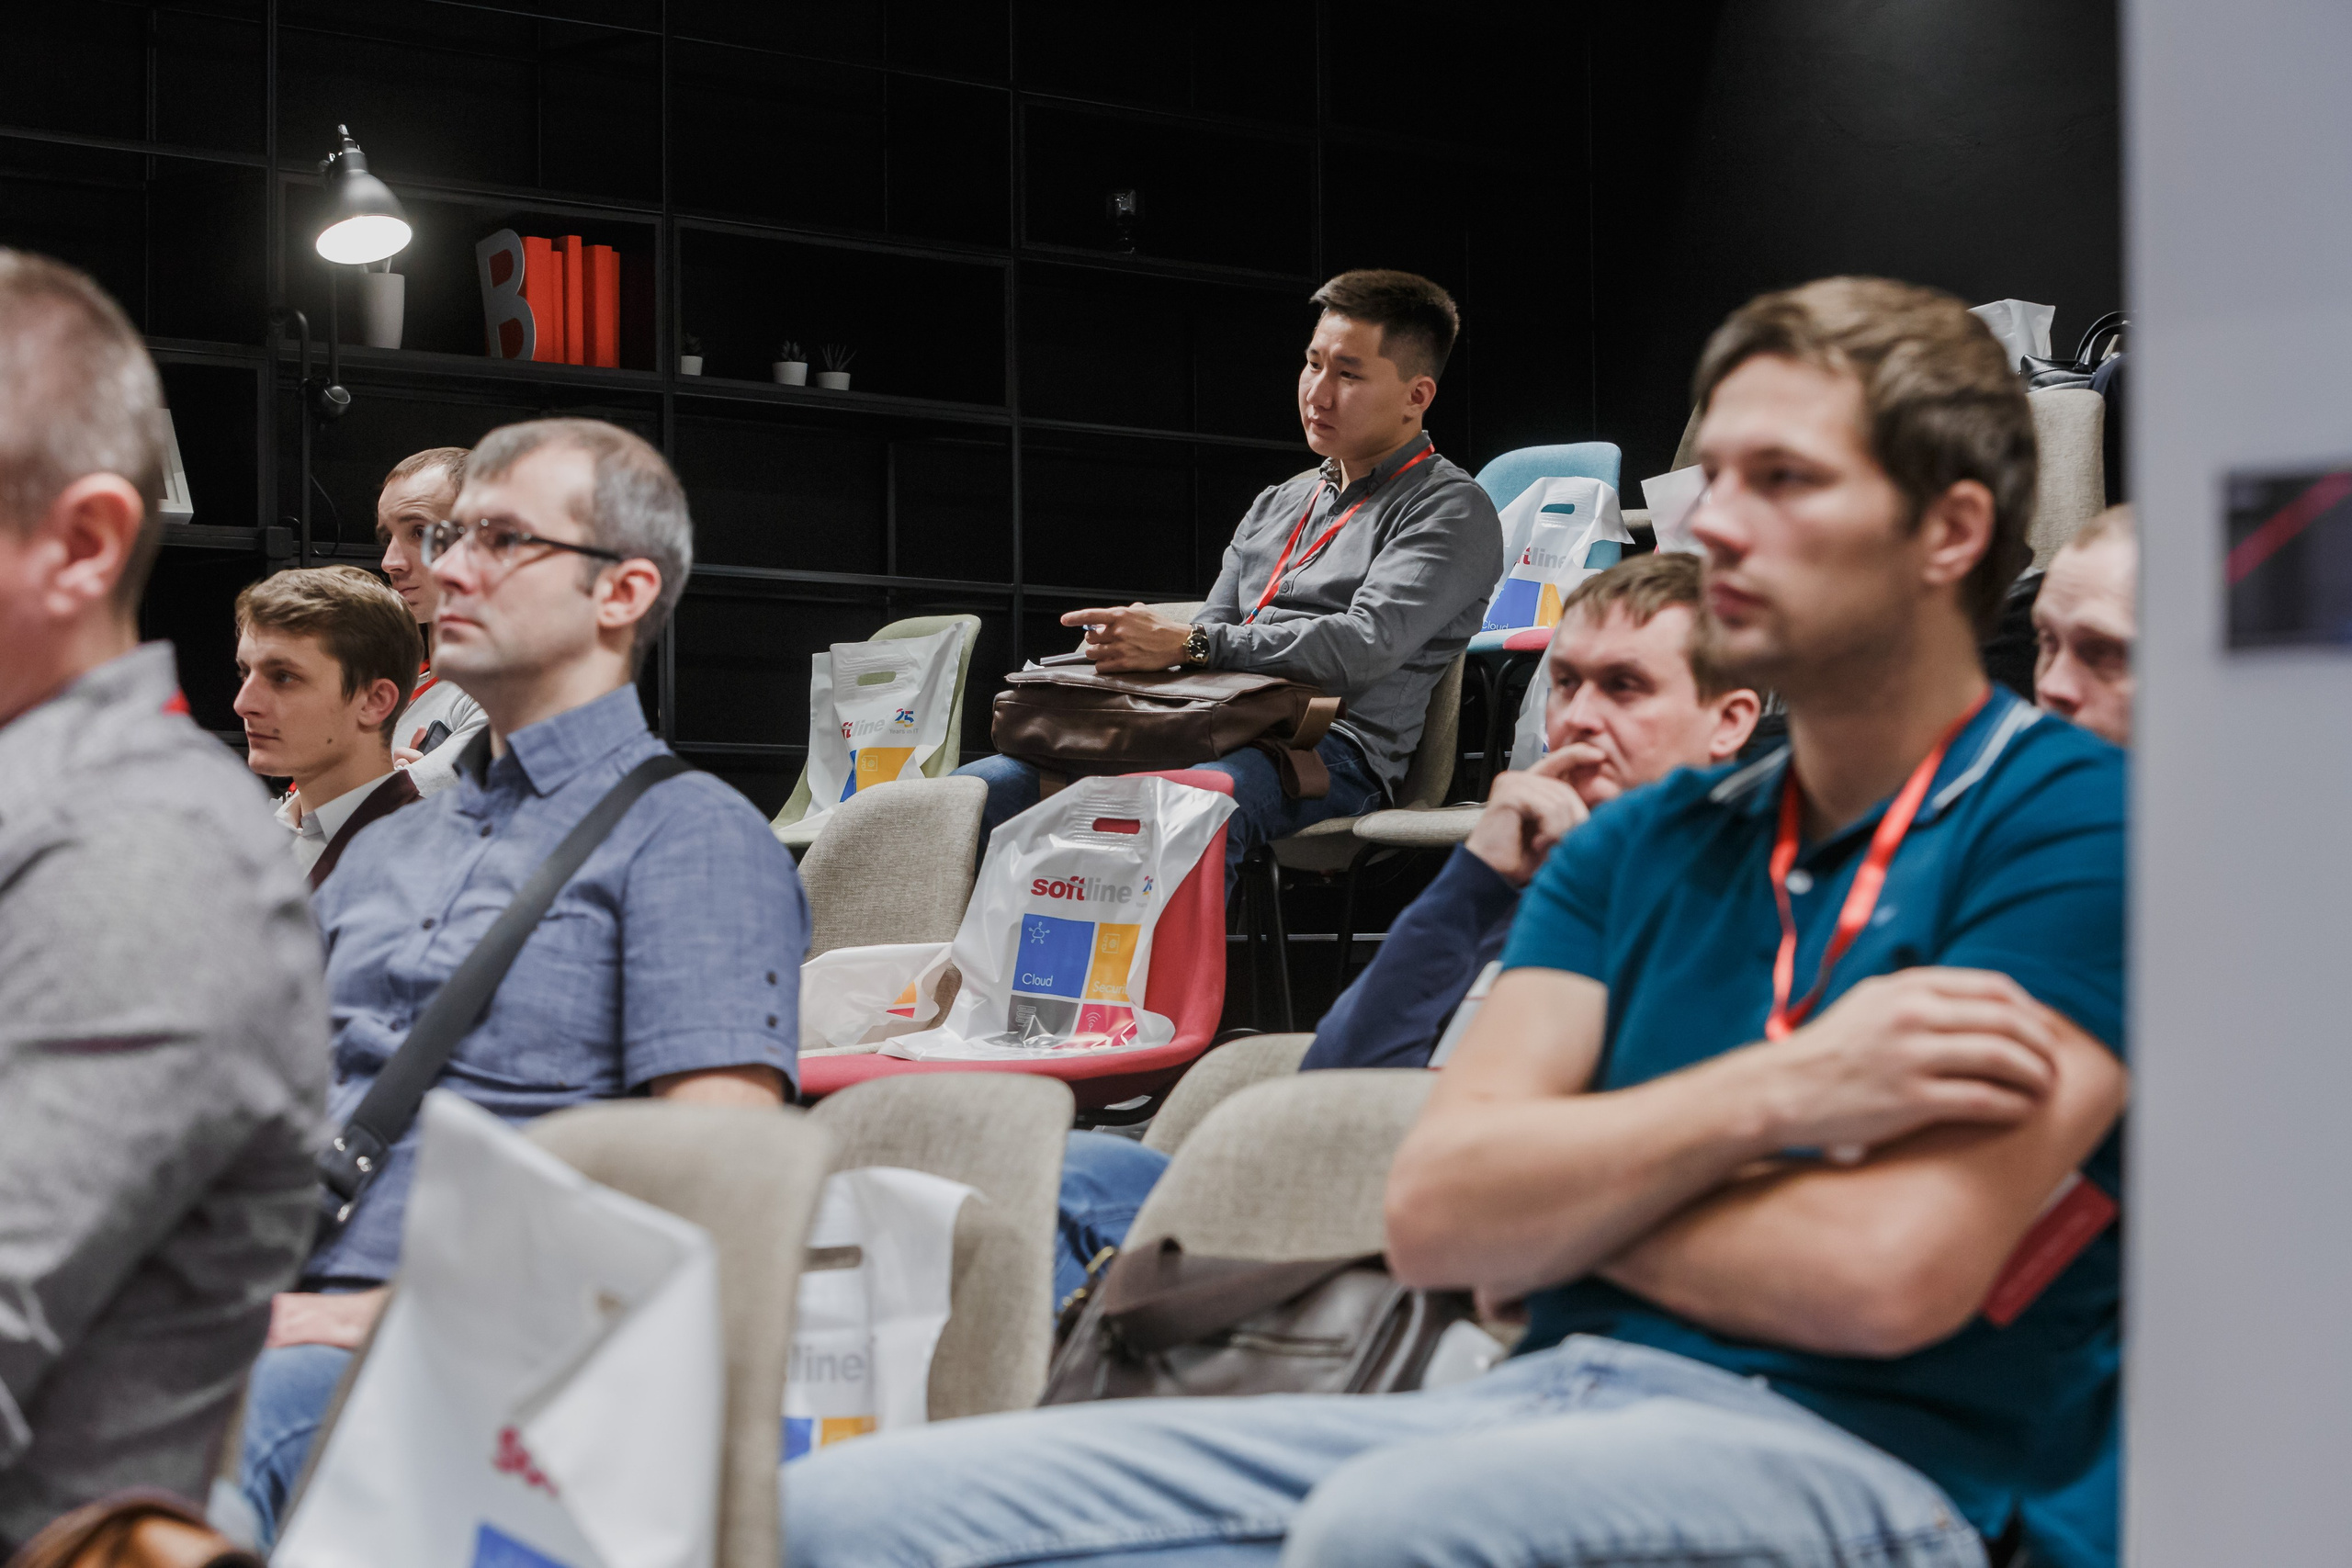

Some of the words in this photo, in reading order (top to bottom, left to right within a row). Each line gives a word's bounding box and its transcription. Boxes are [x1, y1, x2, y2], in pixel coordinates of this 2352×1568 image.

[1482, 619, 1510, 630] Cloud
[894, 708, 914, 728] 25
[1030, 875, 1132, 904] softline
[1022, 973, 1054, 987] Cloud
[1092, 980, 1127, 995] Securi
[787, 1344, 865, 1382] line
